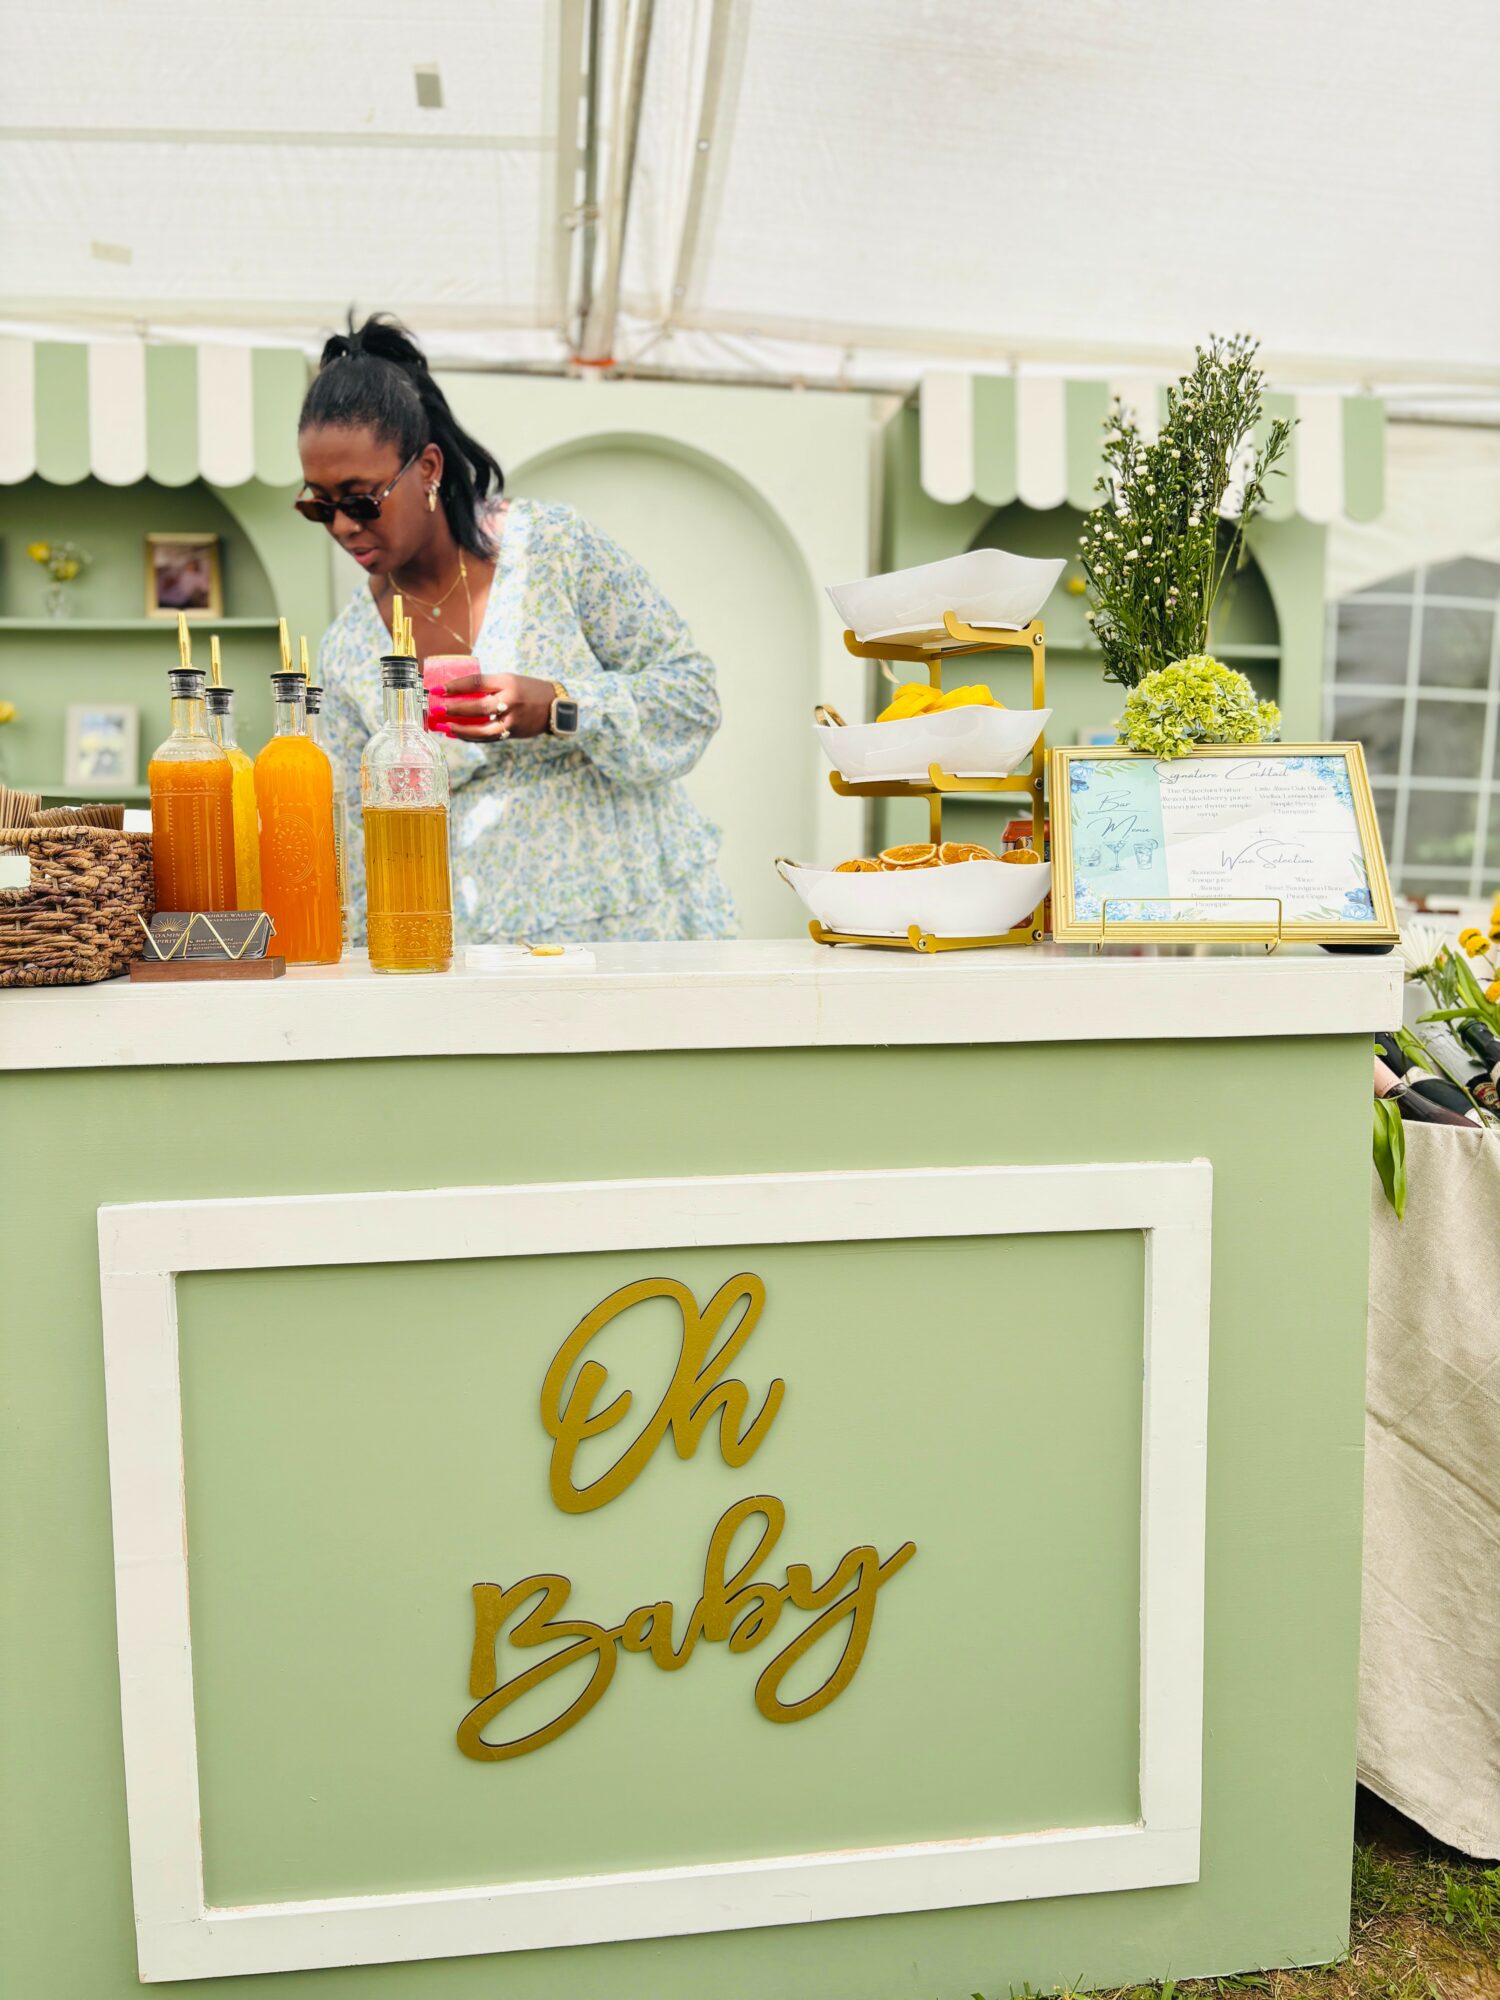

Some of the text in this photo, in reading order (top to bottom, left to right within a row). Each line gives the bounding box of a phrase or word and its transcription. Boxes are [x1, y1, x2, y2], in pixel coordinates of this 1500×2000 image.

[1153, 758, 1288, 785] Signature Cocktail
[1088, 790, 1142, 814] Bar
[1087, 815, 1151, 839] Menu
[1221, 839, 1314, 870] Wine Selection
[540, 1272, 785, 1515] Oh
[456, 1494, 917, 1762] Baby
